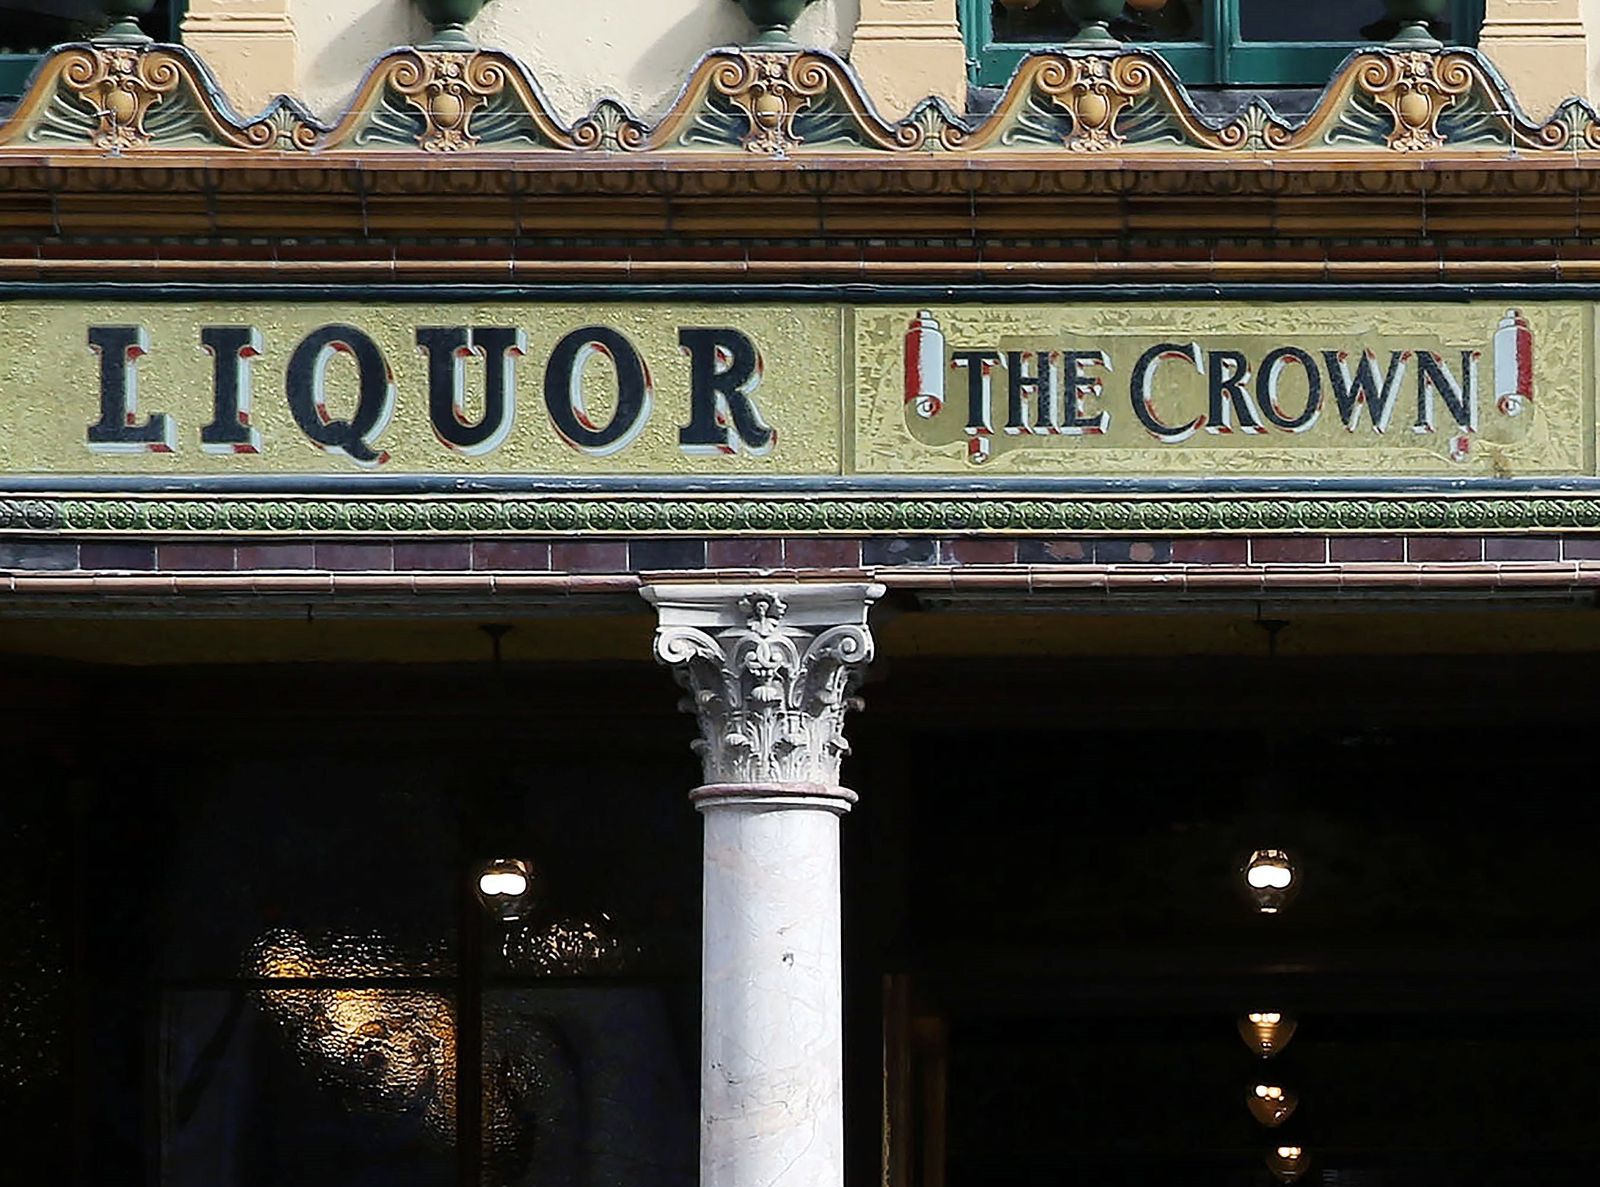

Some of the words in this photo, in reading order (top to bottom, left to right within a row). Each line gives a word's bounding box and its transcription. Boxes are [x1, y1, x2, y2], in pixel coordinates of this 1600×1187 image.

[87, 324, 777, 465] LIQUOR
[951, 350, 1112, 435] THE
[1130, 341, 1481, 443] CROWN
